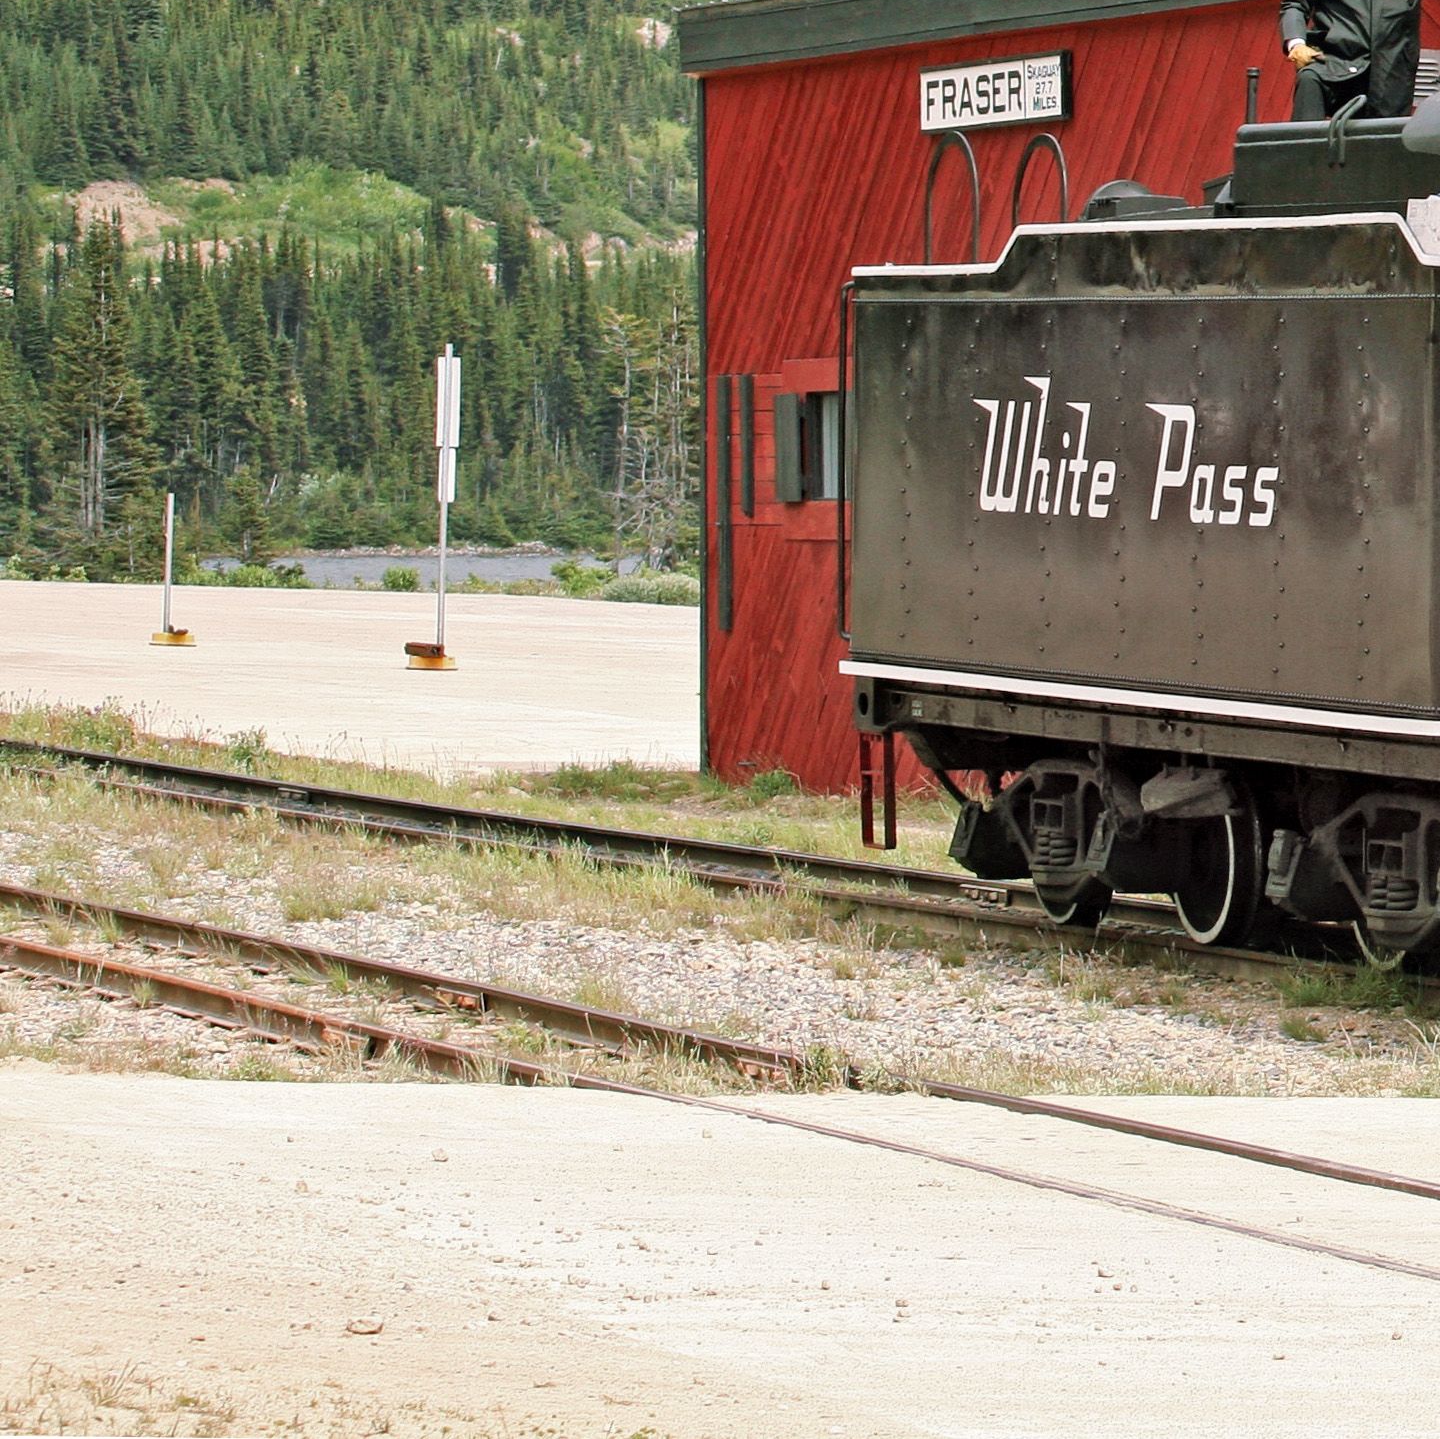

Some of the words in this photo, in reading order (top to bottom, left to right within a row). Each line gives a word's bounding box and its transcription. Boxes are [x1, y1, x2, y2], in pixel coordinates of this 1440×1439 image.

[926, 69, 1022, 121] FRASER
[1035, 80, 1053, 95] 27.7
[972, 375, 1117, 519] White
[1145, 402, 1280, 527] Pass
